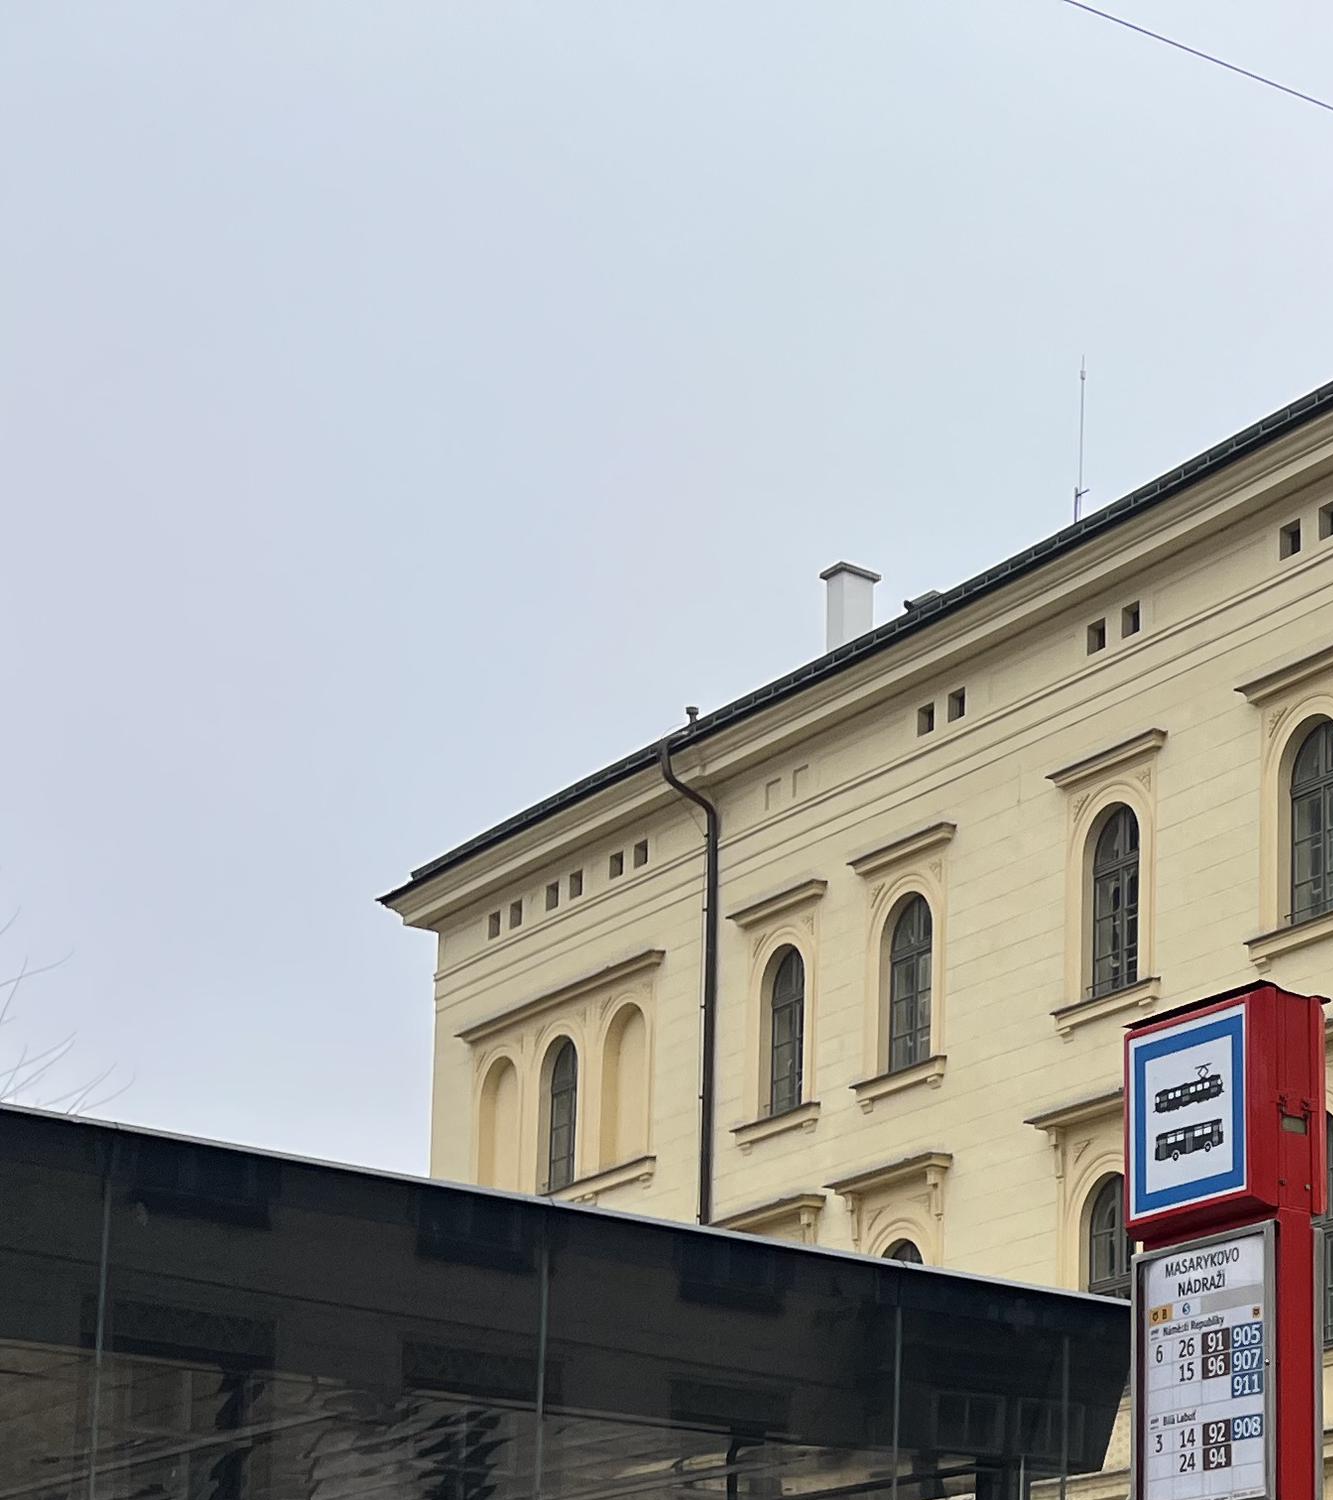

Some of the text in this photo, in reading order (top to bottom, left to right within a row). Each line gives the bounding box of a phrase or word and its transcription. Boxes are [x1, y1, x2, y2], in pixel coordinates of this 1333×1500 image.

[1165, 1247, 1240, 1278] MASARYKOVO
[1178, 1270, 1226, 1297] NÁDRAŽÍ
[1156, 1323, 1261, 1363] 6 26 91 905
[1179, 1348, 1261, 1382] 15 96 907
[1233, 1373, 1261, 1396] 911
[1155, 1416, 1261, 1453] 3 14 92 908
[1179, 1447, 1226, 1473] 24 94
